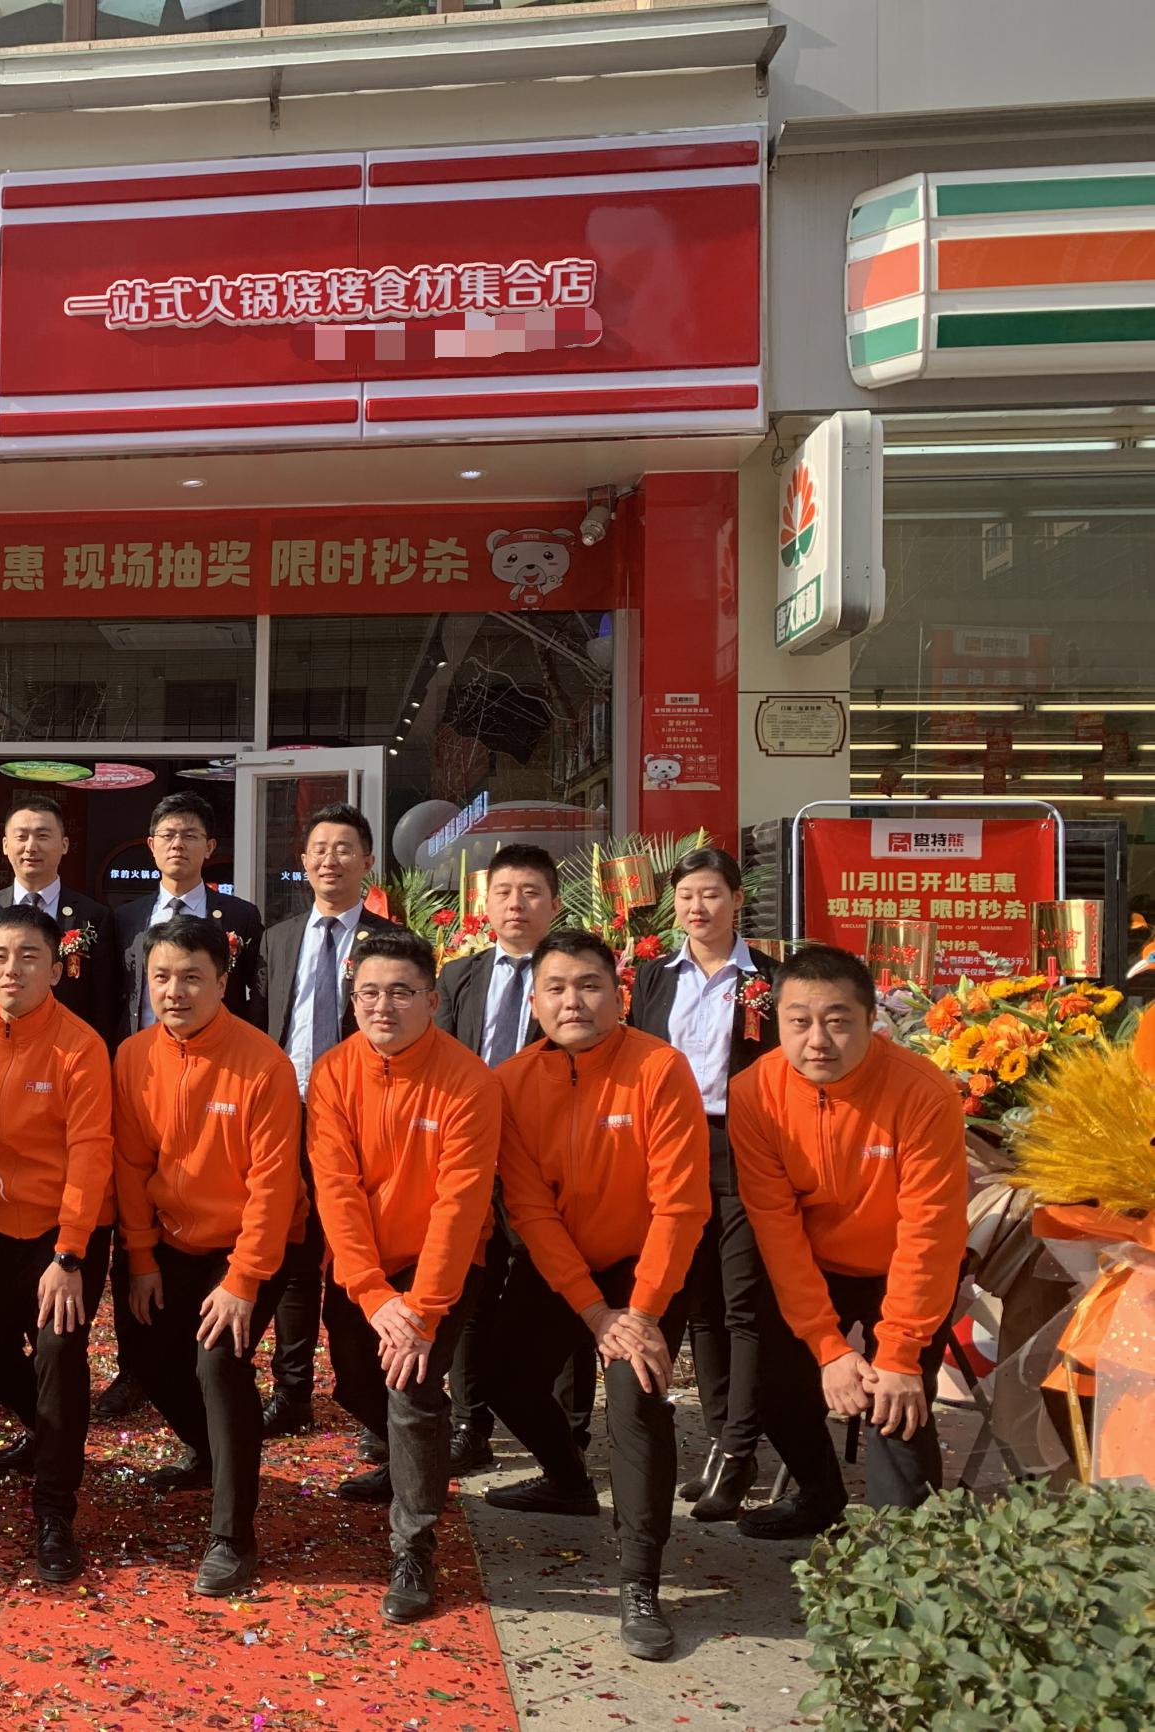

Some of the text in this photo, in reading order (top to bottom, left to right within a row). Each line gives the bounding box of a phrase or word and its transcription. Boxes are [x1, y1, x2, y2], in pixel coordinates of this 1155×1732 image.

[65, 260, 596, 327] 一站式火锅烧烤食材集合店
[62, 540, 252, 590] 现场抽奖
[270, 536, 470, 588] 限时秒杀
[913, 832, 965, 847] 查特熊
[109, 869, 161, 879] 你的火锅必
[827, 898, 1028, 921] 现场抽奖 限时秒杀
